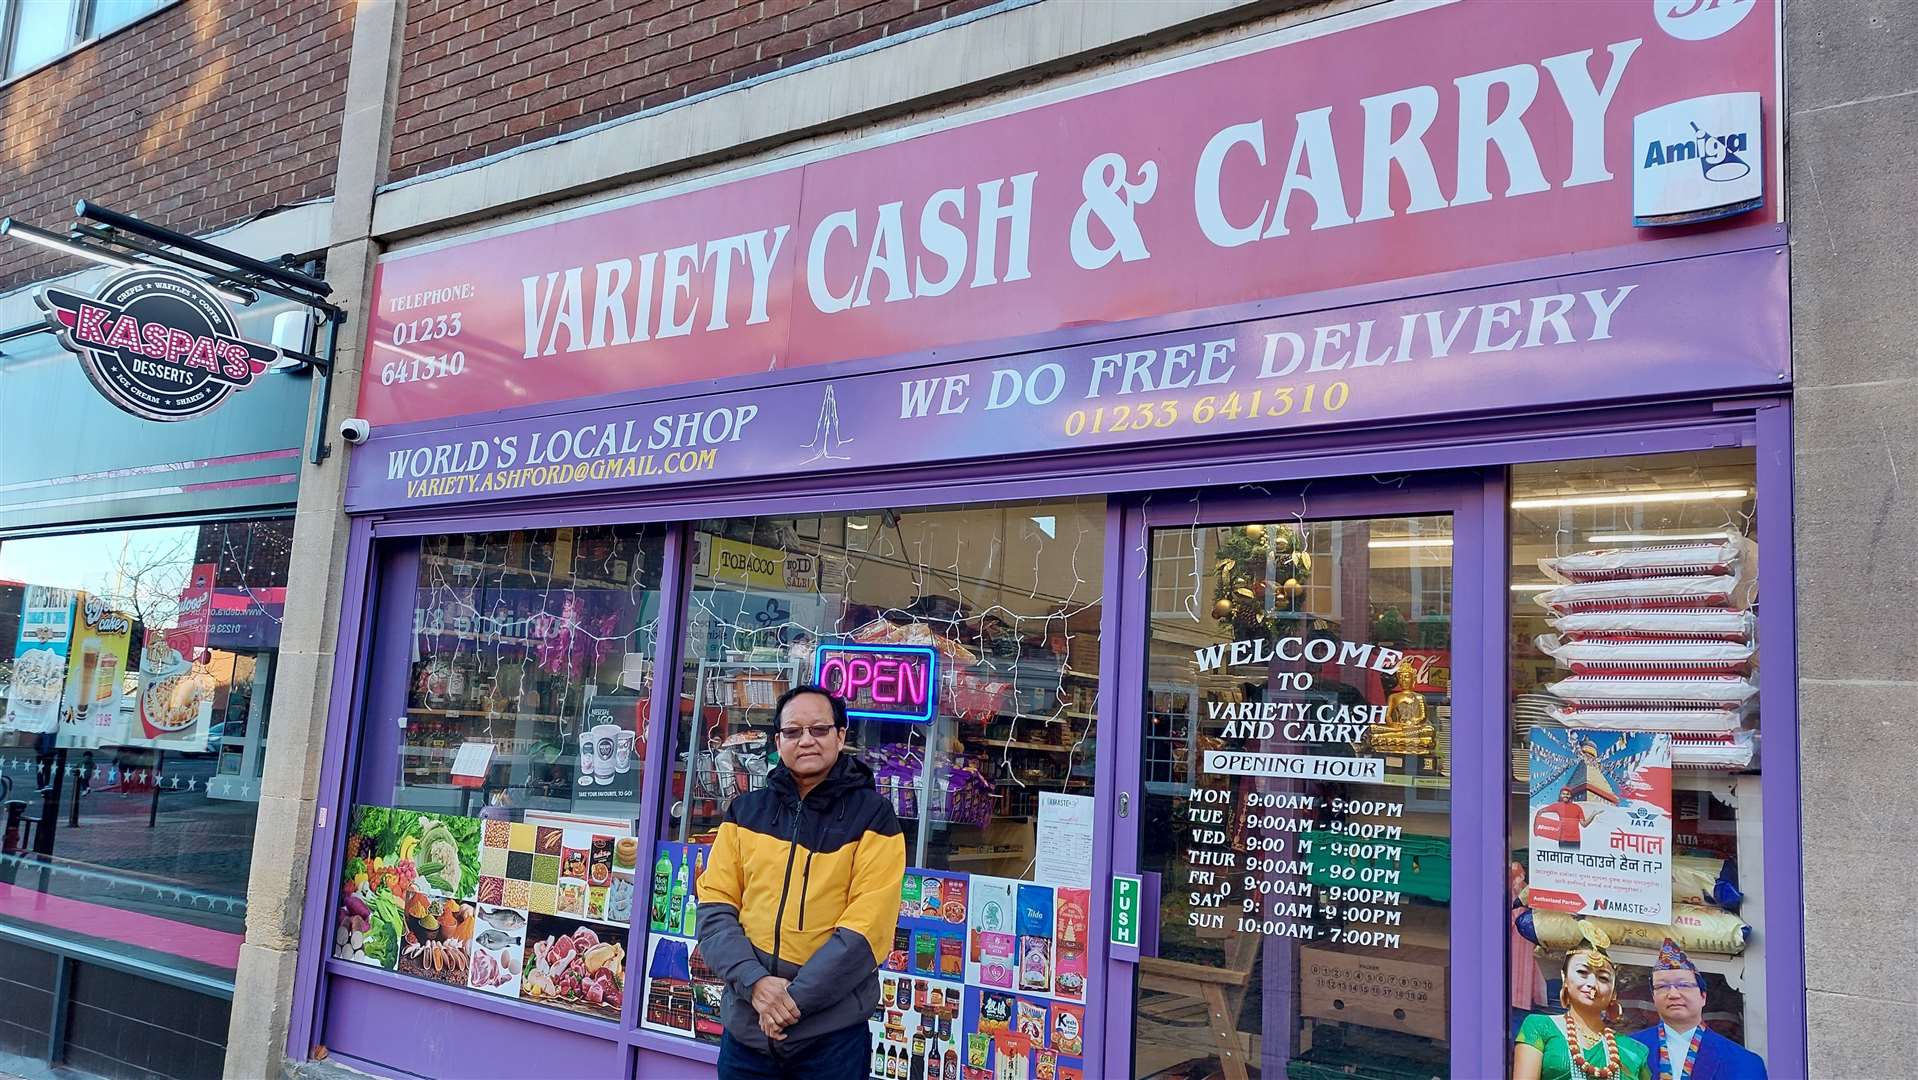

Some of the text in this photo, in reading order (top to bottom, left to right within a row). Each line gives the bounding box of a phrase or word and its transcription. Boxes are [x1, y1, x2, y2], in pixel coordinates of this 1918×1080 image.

[1643, 130, 1747, 169] Amiga
[522, 37, 1643, 359] VARIETY CASH & CARRY
[154, 282, 191, 297] WAFFLES
[389, 283, 475, 312] TELEPHONE:
[199, 299, 222, 324] COFFEE
[76, 304, 250, 379] KASPA'S
[392, 312, 462, 346] 01233
[898, 284, 1639, 420] WE DO FREE DELIVERY
[133, 358, 194, 386] DESSERTS
[381, 351, 465, 386] 641310
[116, 373, 160, 404] ICE CREAM
[176, 392, 204, 406] SHAKES
[1063, 381, 1349, 437] 01233 641310
[526, 420, 641, 465] LOCAL
[648, 404, 759, 450] SHOP
[407, 447, 718, 499] VARIETY.ASHFORD@GMAIL.COM
[721, 551, 775, 576] TOBACCO
[1193, 636, 1403, 675] WELCOME
[820, 658, 927, 706] OPEN
[1277, 672, 1313, 691] TO
[1207, 701, 1389, 725] VARIETY CASH
[1220, 720, 1369, 744] AND CARRY
[1212, 754, 1377, 778] OPENING HOUR
[1189, 788, 1231, 804] MON
[1247, 793, 1314, 811] 9:00AM
[1331, 797, 1404, 818] 9:00PM
[1188, 808, 1223, 824] TUE
[1246, 814, 1314, 833] 9:00AM
[1330, 821, 1402, 841] 9:00PM
[1630, 820, 1655, 828] IATA
[1330, 842, 1402, 862] 9:00PM
[1610, 828, 1665, 855] नेपाल
[1187, 850, 1235, 867] THUR
[1246, 857, 1314, 876] 9:00AM
[1536, 849, 1575, 865] सामान
[1576, 853, 1617, 870] पठाउने
[1620, 853, 1640, 872] हैन
[1188, 870, 1215, 886] FRI
[1244, 876, 1312, 897] 9:00AM
[1329, 886, 1401, 906] 9:00PM
[1189, 892, 1223, 908] SAT
[1026, 907, 1043, 919] Tilda
[1118, 881, 1130, 942] PUSH
[1674, 915, 1702, 927] Atta
[1188, 912, 1224, 929] SUN
[1237, 917, 1314, 940] 10:00AM
[1330, 927, 1401, 949] 7:00PM
